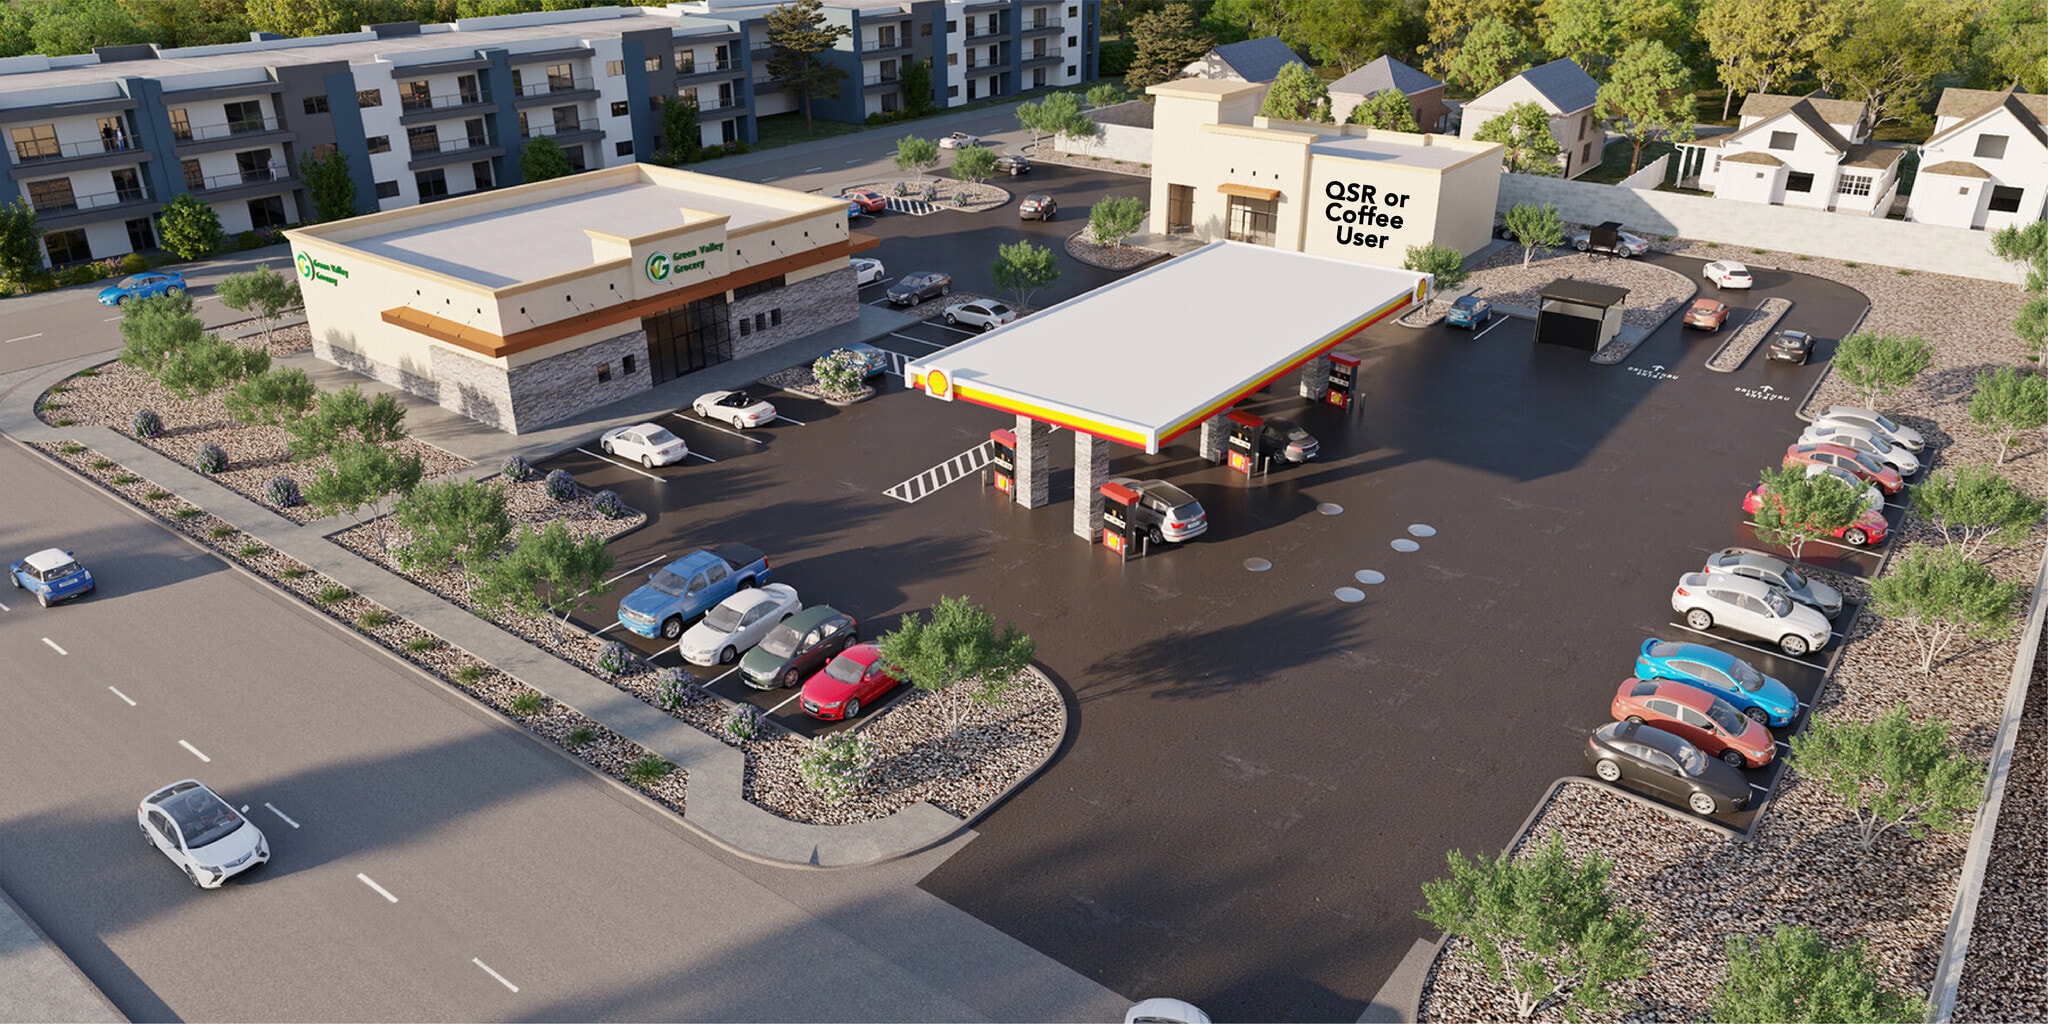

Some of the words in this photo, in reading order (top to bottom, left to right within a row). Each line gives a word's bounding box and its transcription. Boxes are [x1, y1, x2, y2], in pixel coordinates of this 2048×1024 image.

[1325, 180, 1377, 205] QSR
[1384, 193, 1410, 208] or
[1325, 202, 1404, 229] Coffee
[1336, 225, 1389, 249] User
[673, 251, 697, 261] Green
[699, 242, 724, 254] Valley
[674, 260, 705, 274] Grocery
